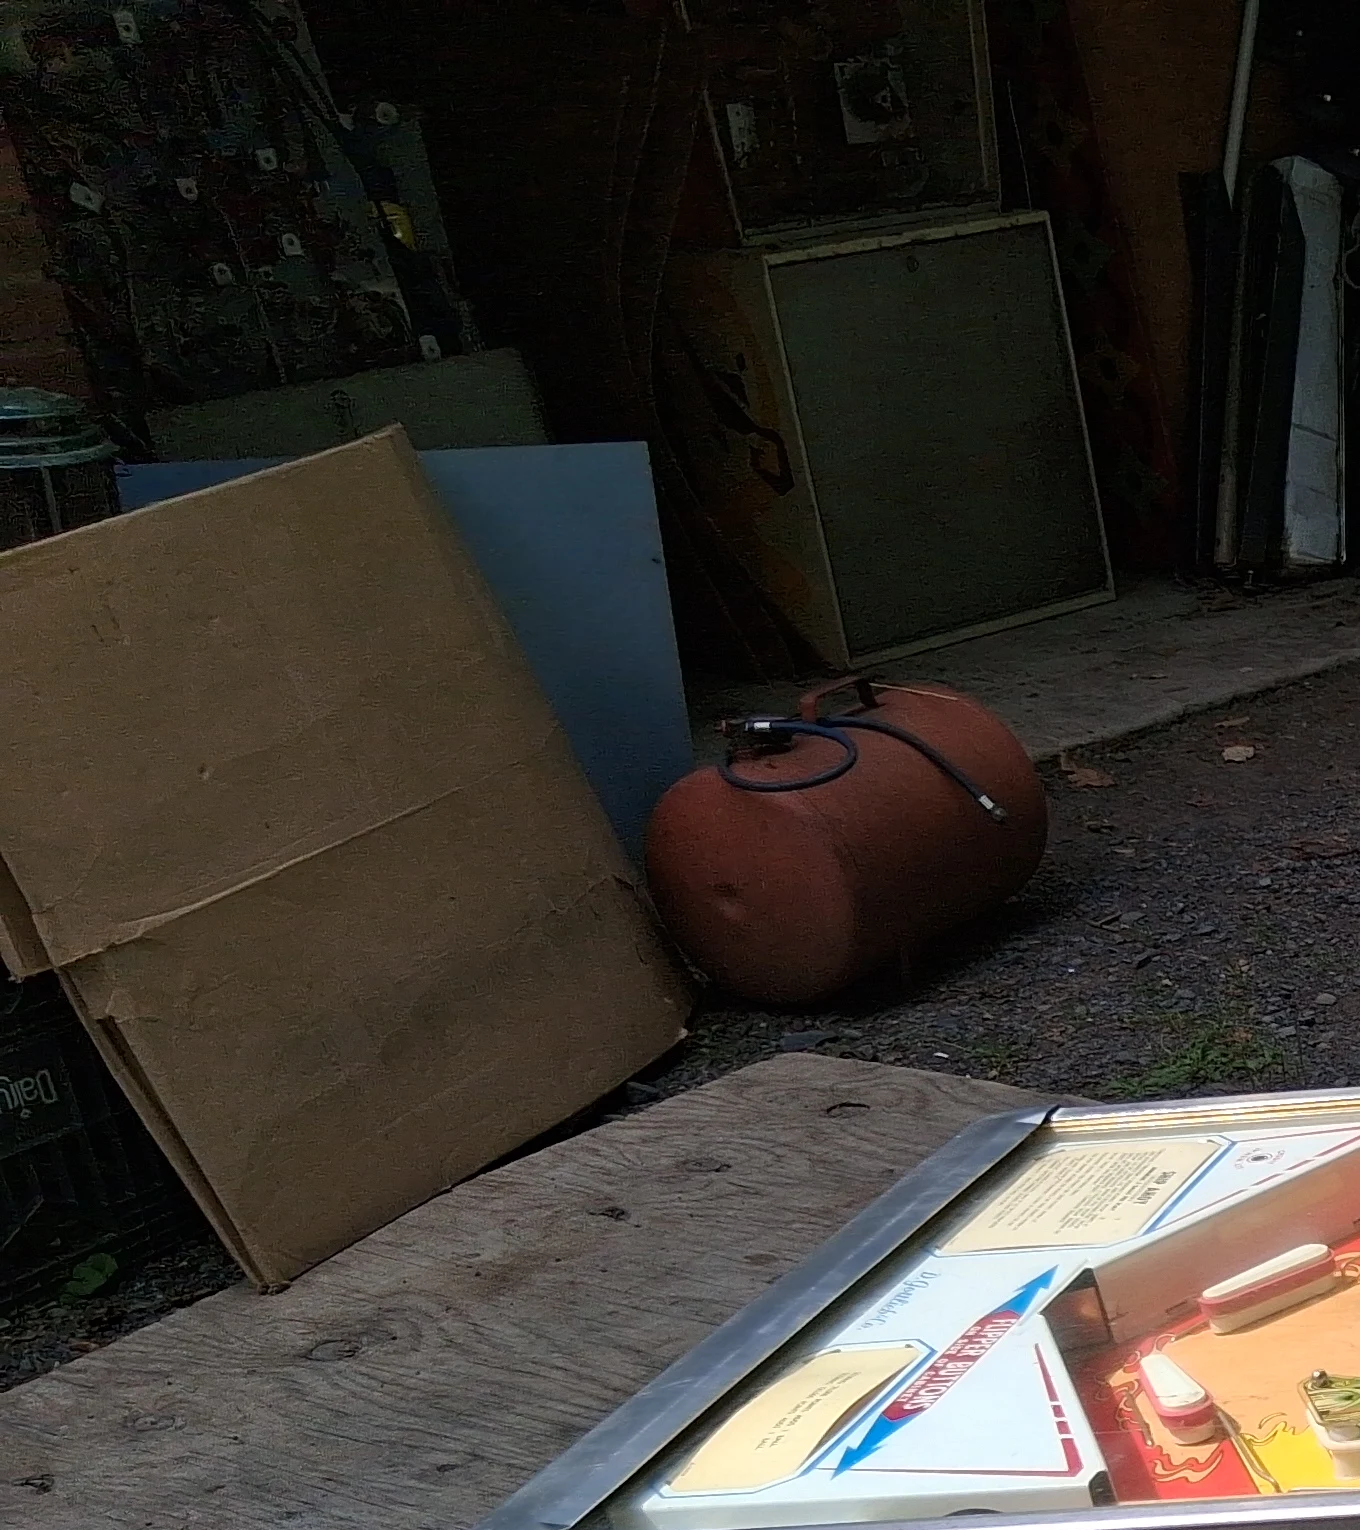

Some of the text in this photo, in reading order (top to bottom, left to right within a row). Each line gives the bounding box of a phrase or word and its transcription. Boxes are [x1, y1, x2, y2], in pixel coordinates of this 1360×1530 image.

[956, 1318, 1018, 1358] FLIPPER
[964, 1326, 983, 1337] ON
[933, 1358, 949, 1368] OF
[897, 1371, 936, 1402] CABINET
[903, 1361, 975, 1411] BUTTONS
